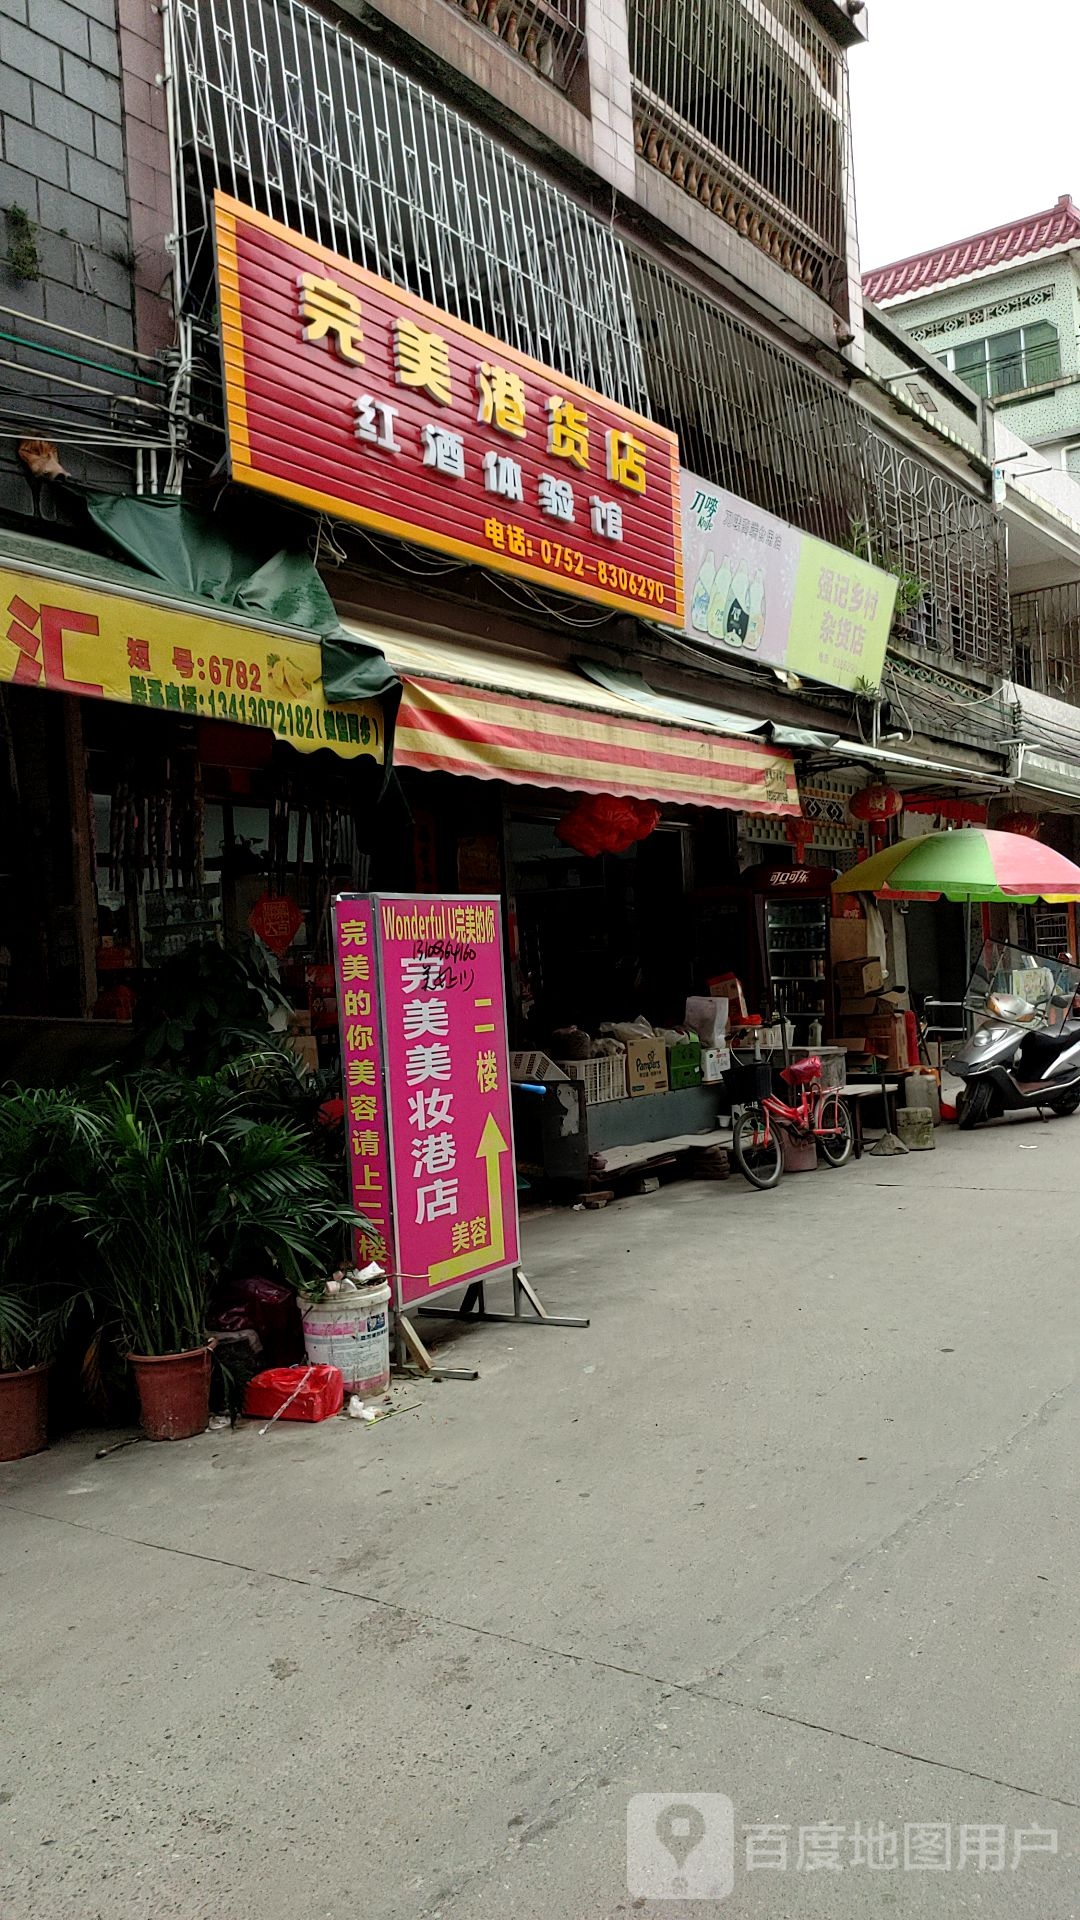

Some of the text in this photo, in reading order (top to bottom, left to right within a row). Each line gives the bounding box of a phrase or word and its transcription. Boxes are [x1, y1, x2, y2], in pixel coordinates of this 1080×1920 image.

[298, 273, 646, 494] 完美港货店
[353, 394, 624, 543] 红酒体验馆
[6, 595, 104, 695] 汇
[382, 906, 445, 941] Wonderful
[769, 870, 810, 885] 可口可乐
[474, 998, 498, 1093] 二楼
[452, 1216, 488, 1253] 美容
